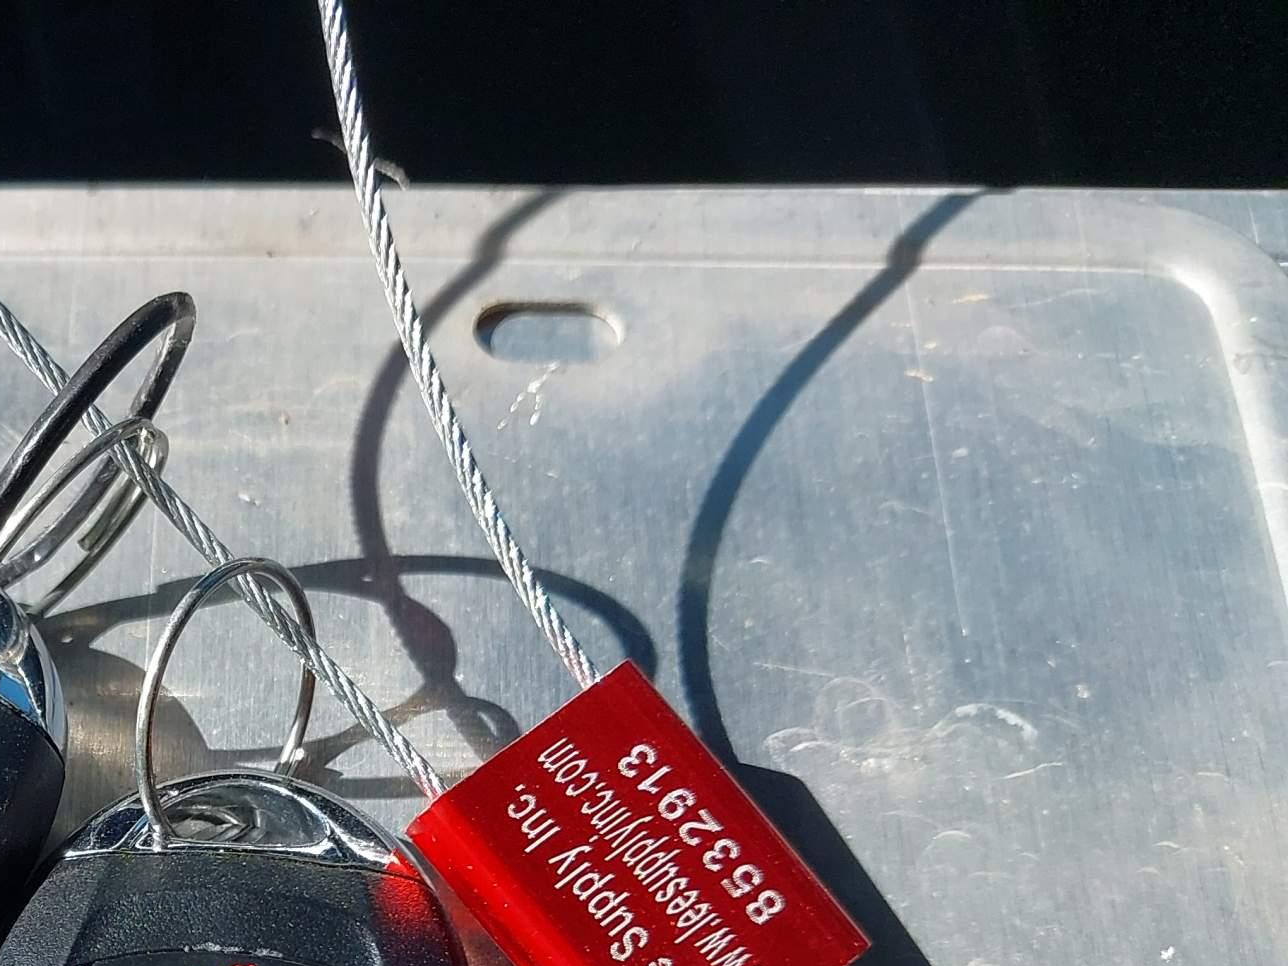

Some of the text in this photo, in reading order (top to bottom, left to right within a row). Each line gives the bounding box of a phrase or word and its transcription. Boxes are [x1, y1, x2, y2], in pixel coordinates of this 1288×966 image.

[507, 783, 561, 854] Inc.
[617, 743, 785, 926] 8532913
[547, 845, 649, 962] Supply
